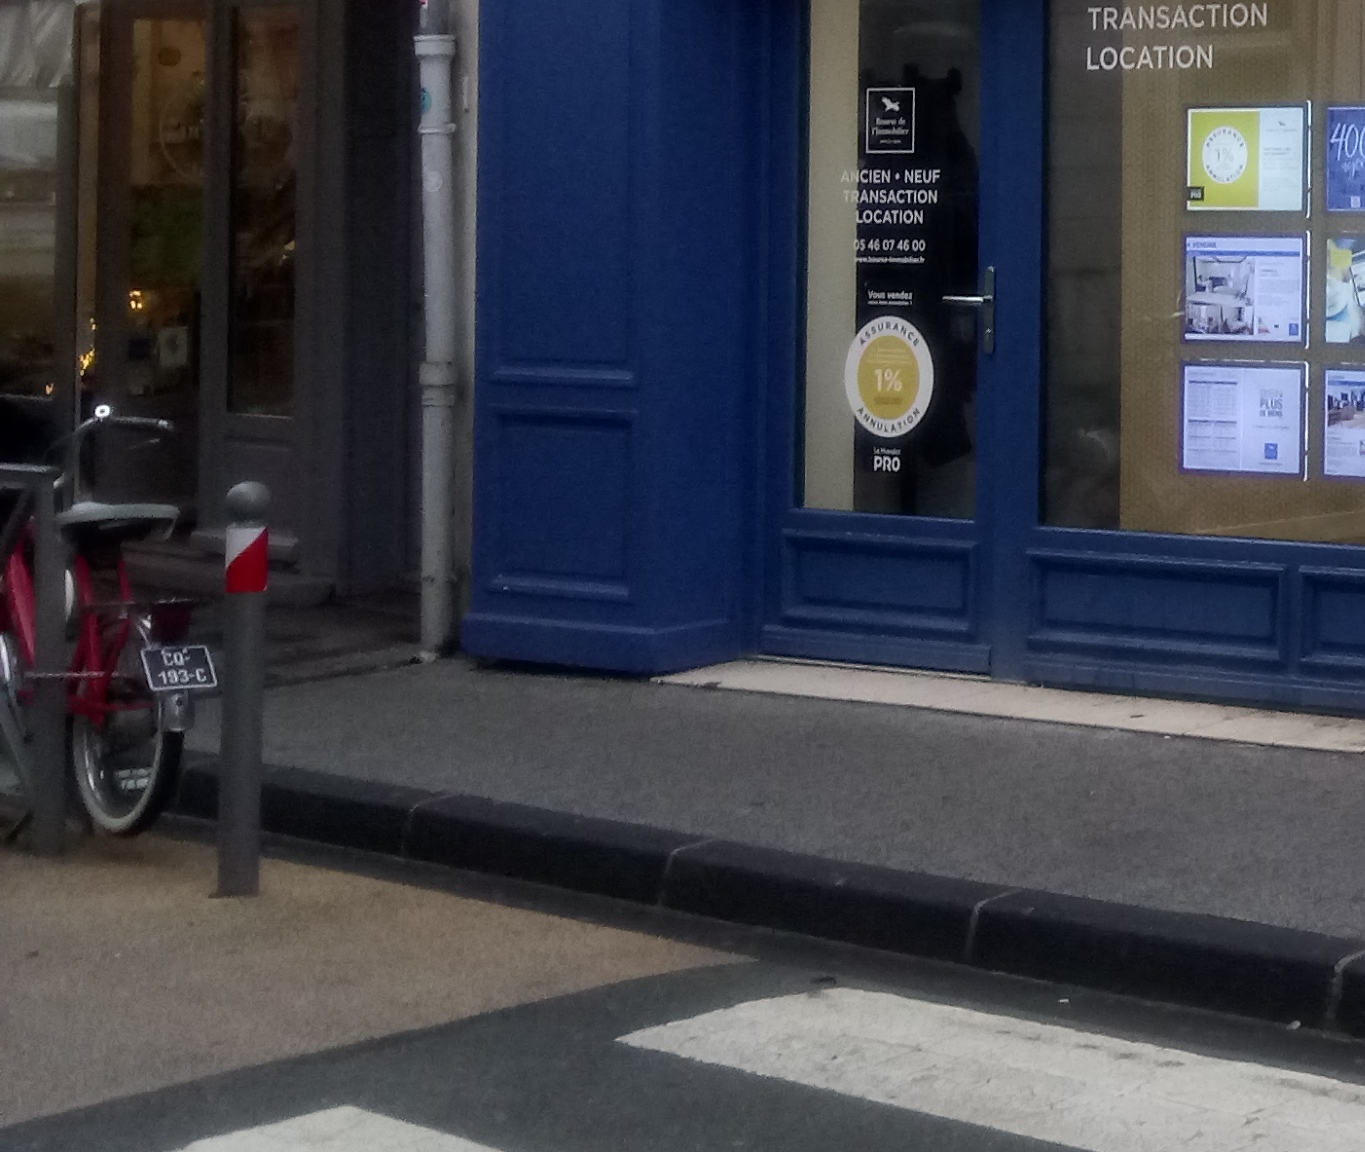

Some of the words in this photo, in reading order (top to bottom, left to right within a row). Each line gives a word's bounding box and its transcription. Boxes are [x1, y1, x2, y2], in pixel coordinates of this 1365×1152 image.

[1087, 2, 1269, 32] TRANSACTION
[1086, 44, 1215, 71] LOCATION
[840, 169, 892, 184] ANCIEN
[904, 169, 942, 184] NEUF
[843, 189, 938, 205] TRANSACTION
[855, 209, 925, 225] LOCATION
[853, 239, 866, 252] 05
[867, 238, 881, 252] 46
[882, 238, 896, 252] 07
[897, 239, 911, 252] 46
[912, 239, 927, 252] 00
[867, 290, 886, 300] Vous
[887, 290, 914, 301] vendez
[859, 321, 920, 348] ASSURANCE
[873, 367, 904, 393] 1%
[857, 407, 921, 434] ANNULATION
[873, 455, 902, 473] PRO
